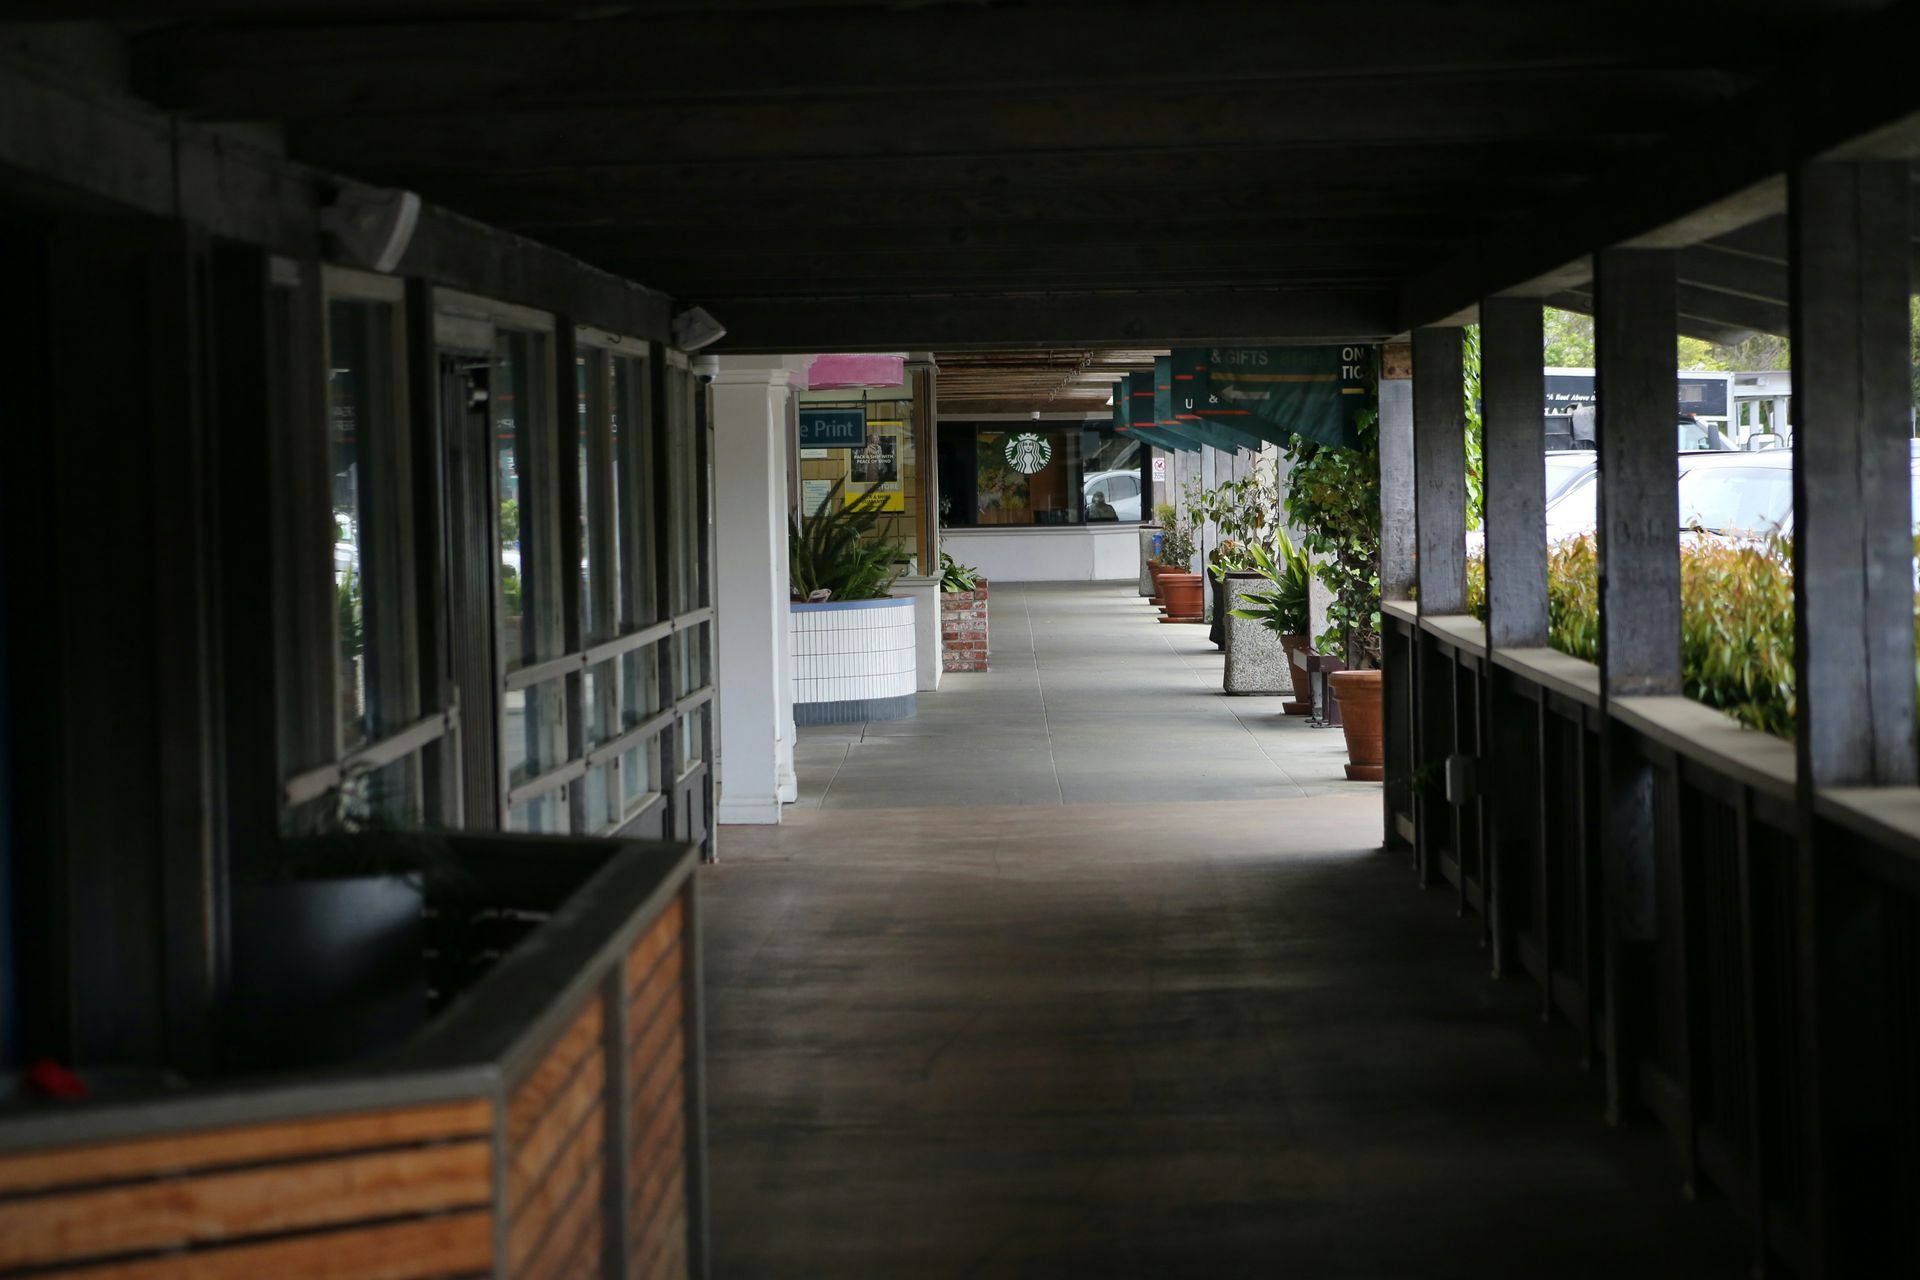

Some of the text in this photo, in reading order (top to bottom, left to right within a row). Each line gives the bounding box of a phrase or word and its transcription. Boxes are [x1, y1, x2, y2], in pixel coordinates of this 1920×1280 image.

[1211, 350, 1221, 363] &
[1226, 351, 1269, 365] GIFTS
[1209, 394, 1218, 404] &
[1571, 393, 1590, 401] Above
[815, 419, 854, 438] Print
